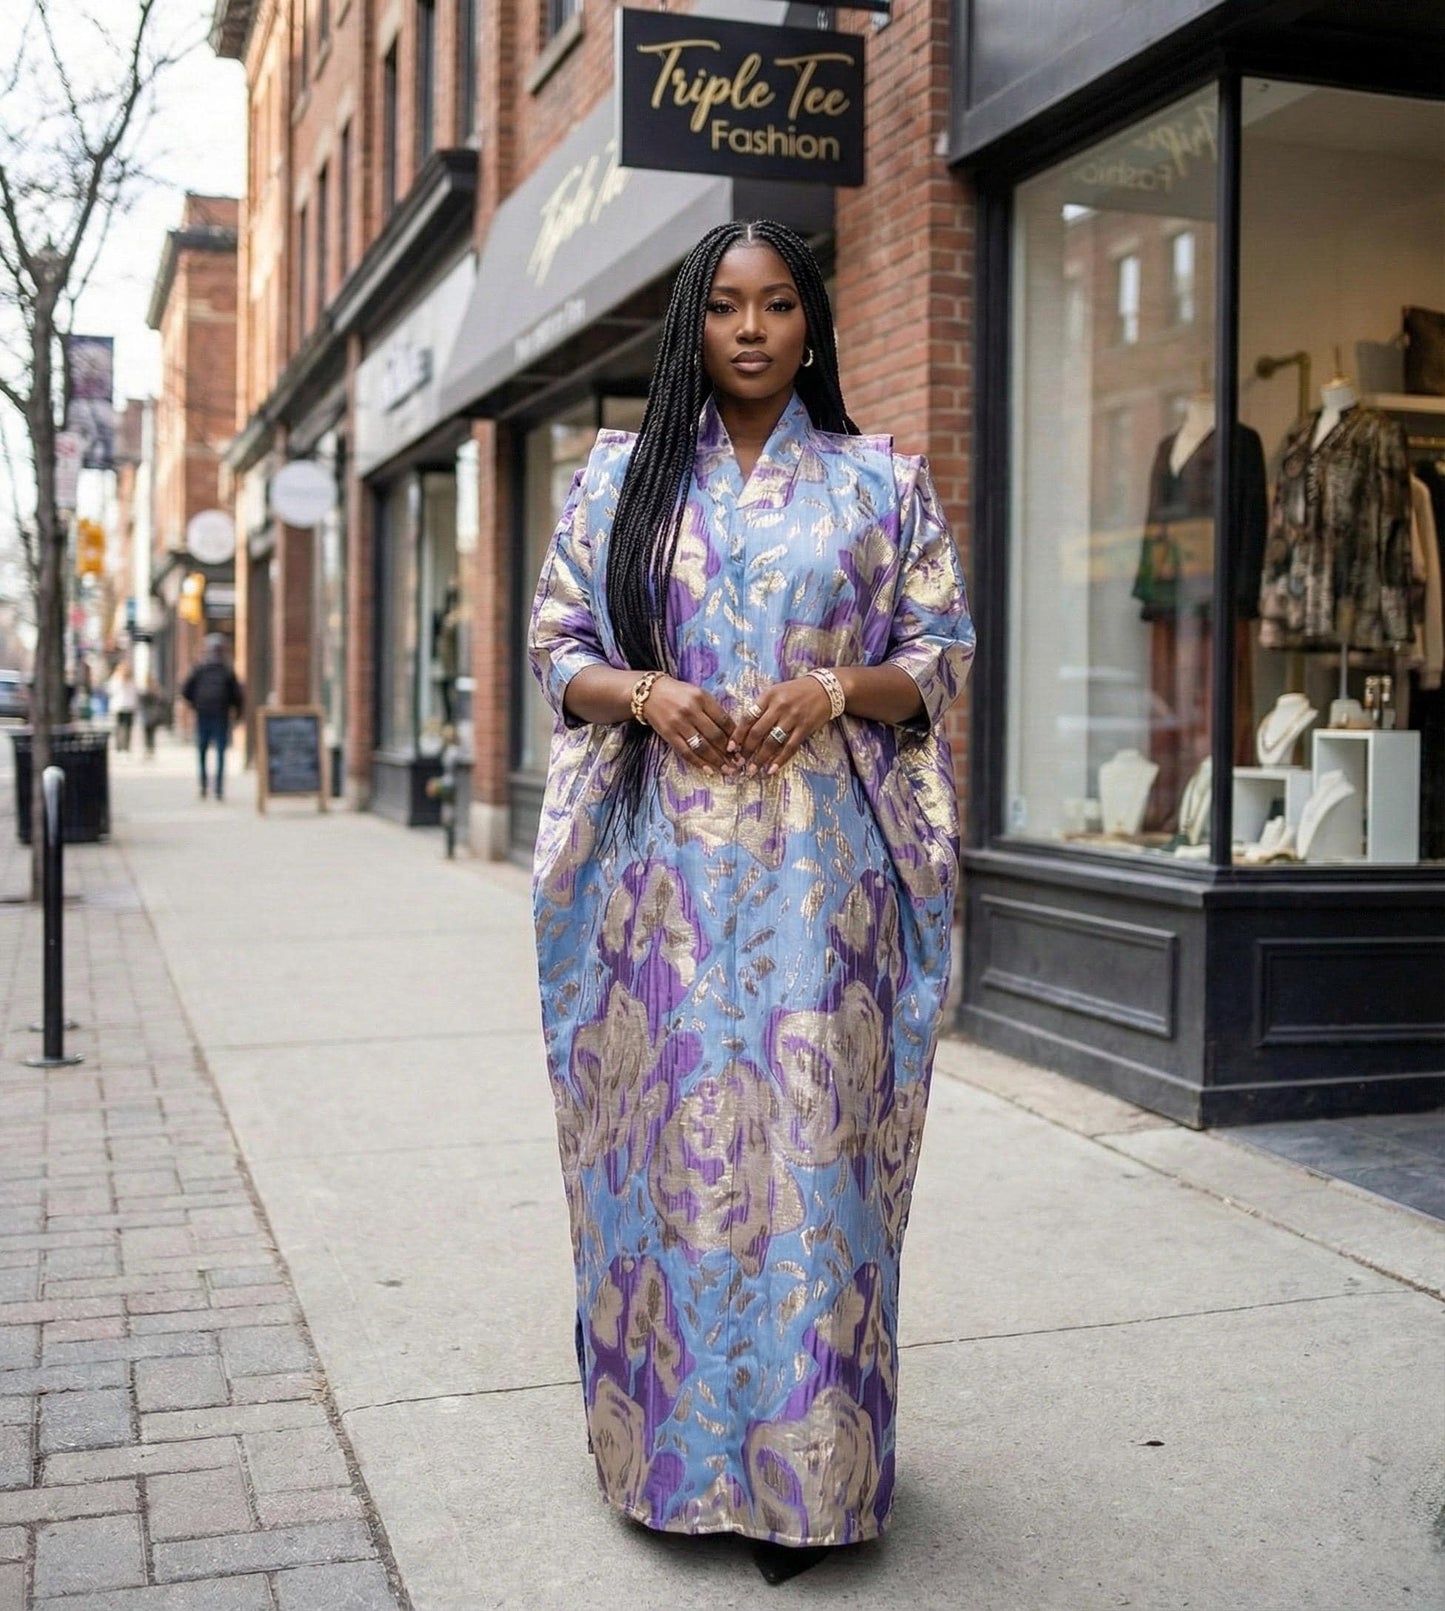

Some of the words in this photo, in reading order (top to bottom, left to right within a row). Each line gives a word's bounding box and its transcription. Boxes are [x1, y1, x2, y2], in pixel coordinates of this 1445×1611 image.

[637, 39, 775, 133] Triple
[774, 53, 854, 121] Tee
[711, 119, 840, 161] Fashion
